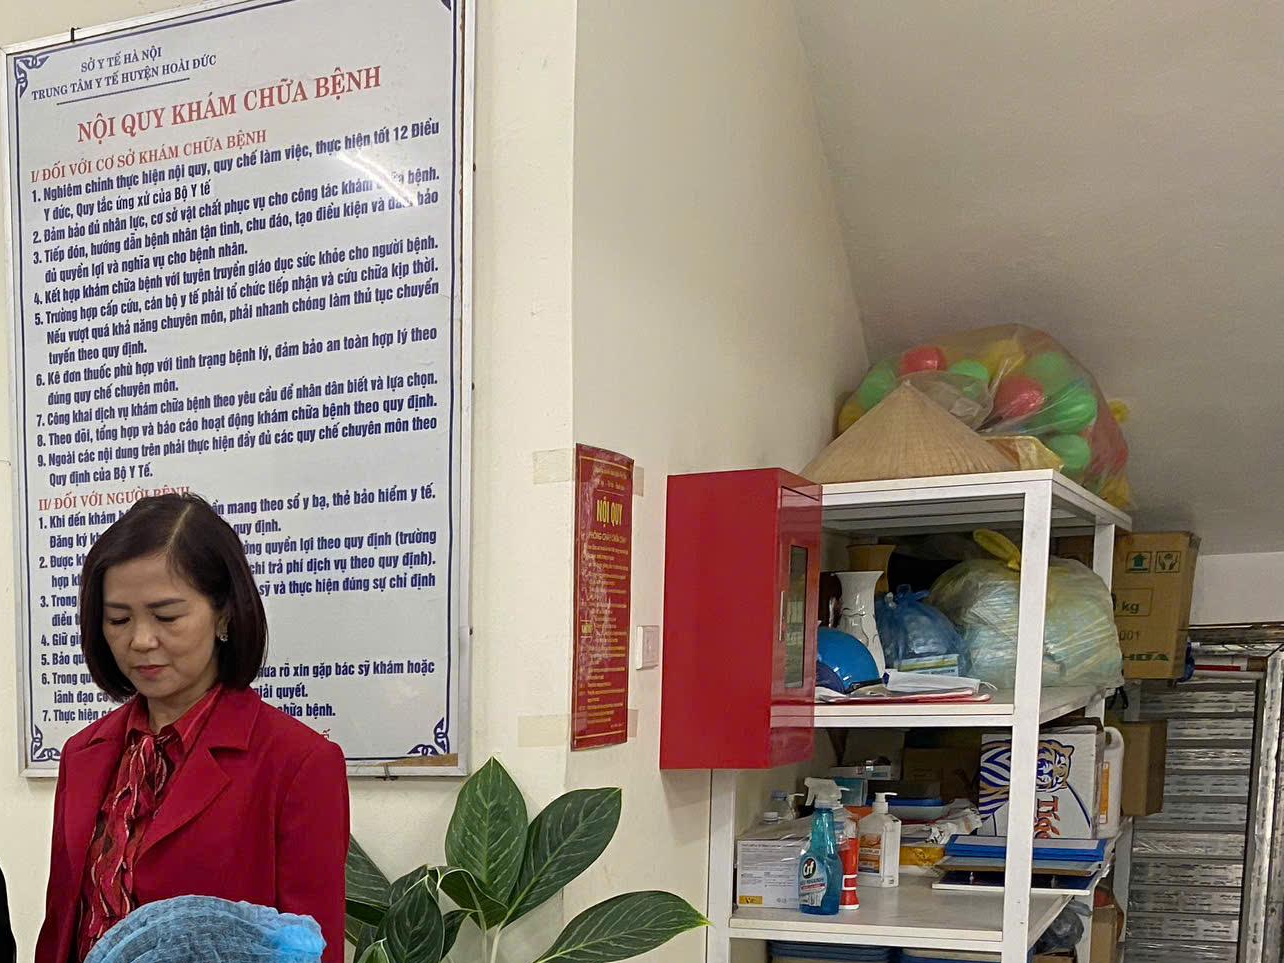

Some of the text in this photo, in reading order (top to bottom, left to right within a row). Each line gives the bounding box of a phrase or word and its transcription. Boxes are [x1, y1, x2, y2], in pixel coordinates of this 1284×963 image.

[80, 44, 161, 72] SỞ Y TẾ HÀ NỘI
[30, 53, 216, 100] TRUNG TÂM Y TẾ HUYỆN HOÀI ĐỨC
[77, 65, 380, 144] NỘI QUY KHÁM CHỮA BỆNH
[31, 189, 41, 203] 1.
[43, 182, 82, 201] Nghiêm
[115, 173, 139, 190] thực
[141, 168, 165, 185] hiện
[167, 163, 185, 182] nội
[187, 162, 210, 178] quy,
[213, 157, 233, 173] quy
[235, 148, 257, 168] chế
[259, 148, 281, 164] làm
[284, 143, 312, 161] việc,
[315, 138, 341, 155] thực
[373, 125, 389, 144] tốt
[392, 124, 408, 141] 12
[41, 160, 66, 181] ĐỐI
[68, 157, 92, 176] VỚI
[95, 154, 114, 171] CƠ
[116, 147, 135, 168] SỞ
[138, 143, 178, 164] KHÁM
[183, 136, 222, 156] CHỮA
[226, 129, 266, 150] BỆNH
[43, 207, 50, 221] Y
[52, 203, 73, 220] đức,
[75, 202, 94, 217] Quy
[115, 194, 134, 210] ứng
[152, 187, 171, 204] của
[173, 184, 187, 202] Bộ
[190, 183, 197, 202] Y
[199, 178, 211, 196] tế
[48, 339, 147, 365] tuyến theo quy định.
[49, 461, 153, 487] Quy định của Bộ Y Tế.
[53, 490, 77, 509] ĐỐI
[79, 490, 103, 507] VỚI
[226, 501, 257, 514] mang
[259, 497, 283, 512] theo
[302, 496, 309, 510] y
[311, 493, 329, 510] bạ,
[331, 489, 350, 506] thẻ
[353, 487, 374, 504] bảo
[377, 484, 407, 502] hiểm
[410, 488, 417, 502] y
[420, 481, 435, 499] tế.
[596, 496, 622, 528] NỘI QUY
[1122, 601, 1140, 614] kg
